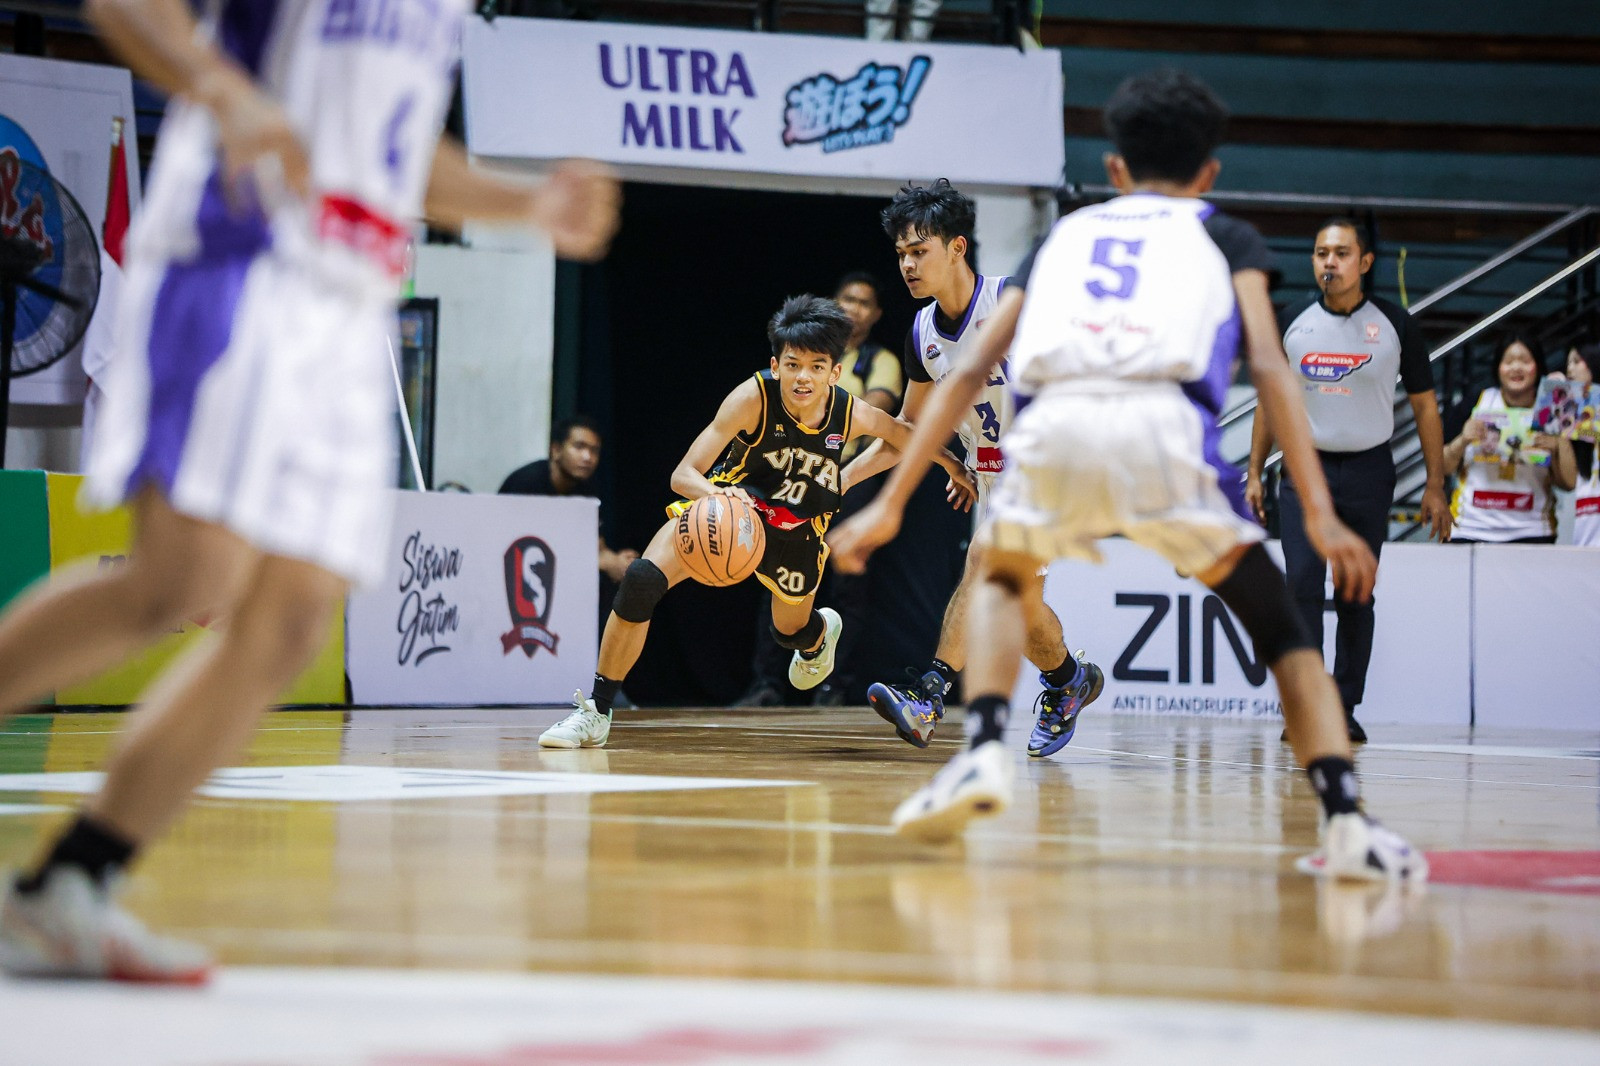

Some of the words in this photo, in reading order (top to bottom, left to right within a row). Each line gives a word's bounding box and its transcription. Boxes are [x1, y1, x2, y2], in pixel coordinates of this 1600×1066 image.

[599, 43, 757, 98] ULTRA
[622, 102, 745, 153] MILK
[1085, 237, 1145, 300] 5
[1316, 366, 1335, 376] DBL
[1317, 356, 1354, 365] HONDA
[973, 401, 1000, 443] 3
[771, 478, 808, 506] 20
[399, 530, 463, 593] Siswa
[776, 565, 806, 593] 20
[1112, 592, 1269, 688] ZIN
[1113, 695, 1151, 711] ANTI
[1156, 696, 1248, 715] DANDRUFF
[1252, 699, 1285, 716] SHA
